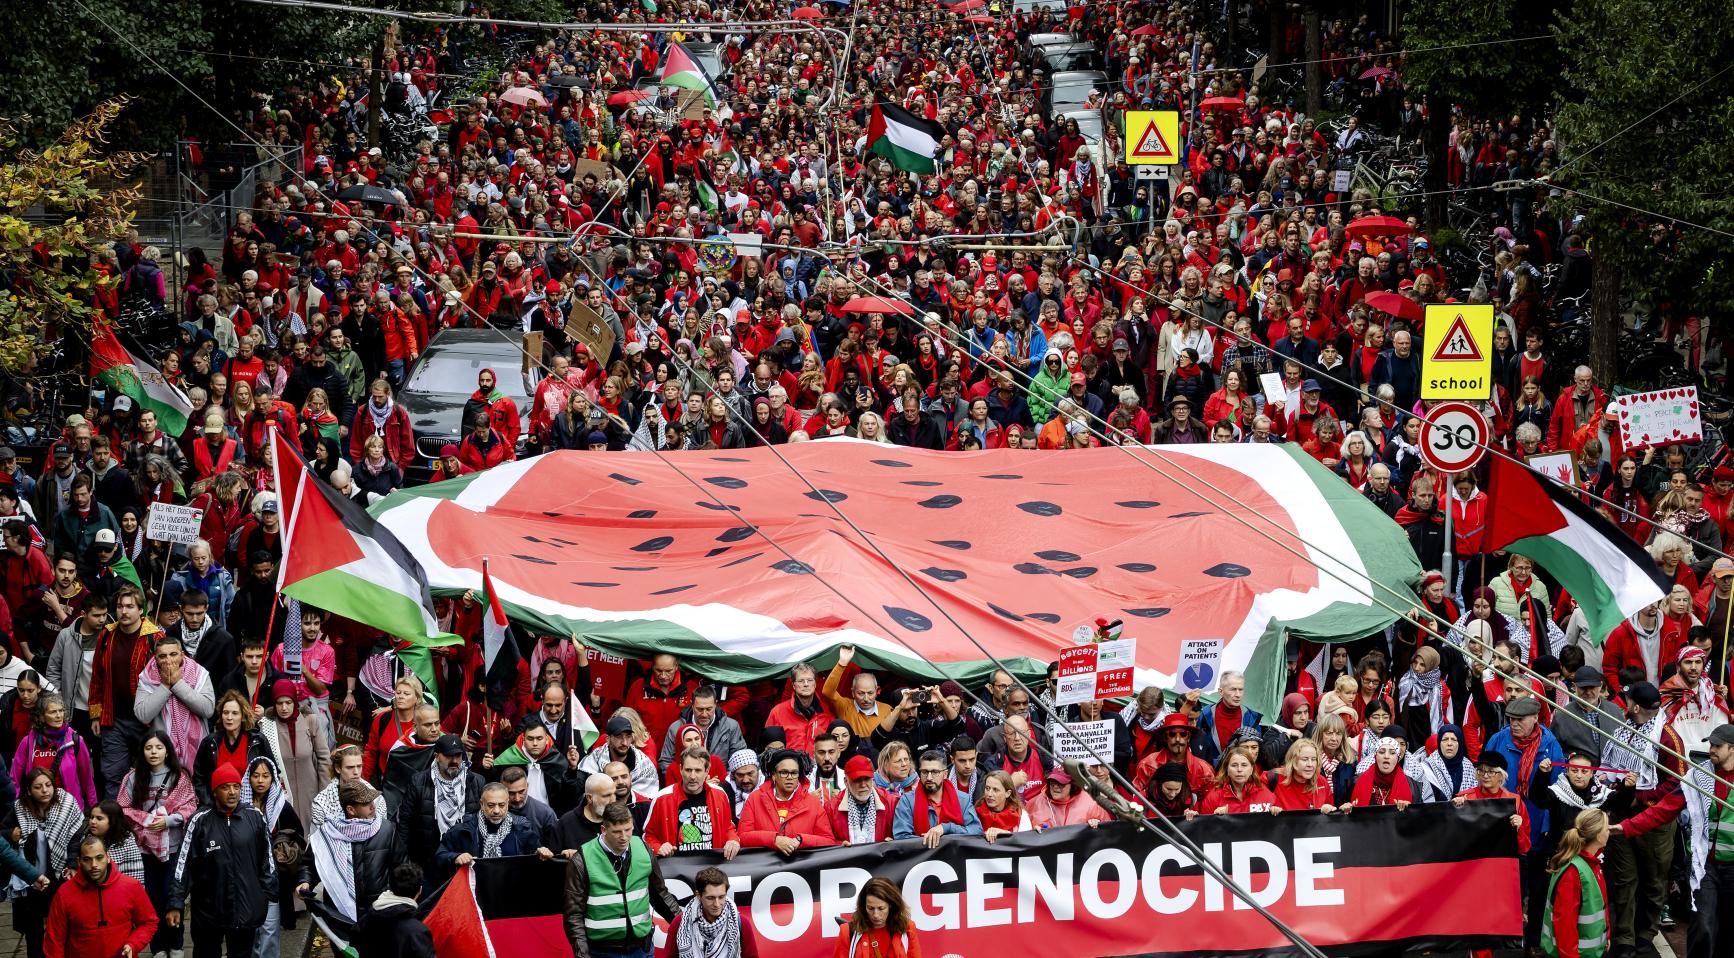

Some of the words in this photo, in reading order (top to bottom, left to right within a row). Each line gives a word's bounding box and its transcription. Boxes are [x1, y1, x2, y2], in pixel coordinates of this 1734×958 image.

[1430, 377, 1482, 389] school
[1433, 424, 1476, 450] 30
[599, 652, 624, 665] MEER
[1060, 648, 1098, 660] BOYCOTT
[1184, 652, 1218, 660] PATIENTS
[1103, 672, 1128, 682] FREE
[1061, 684, 1073, 693] BDS
[679, 840, 713, 851] PALESTINE
[902, 835, 1345, 932] GENOCIDE
